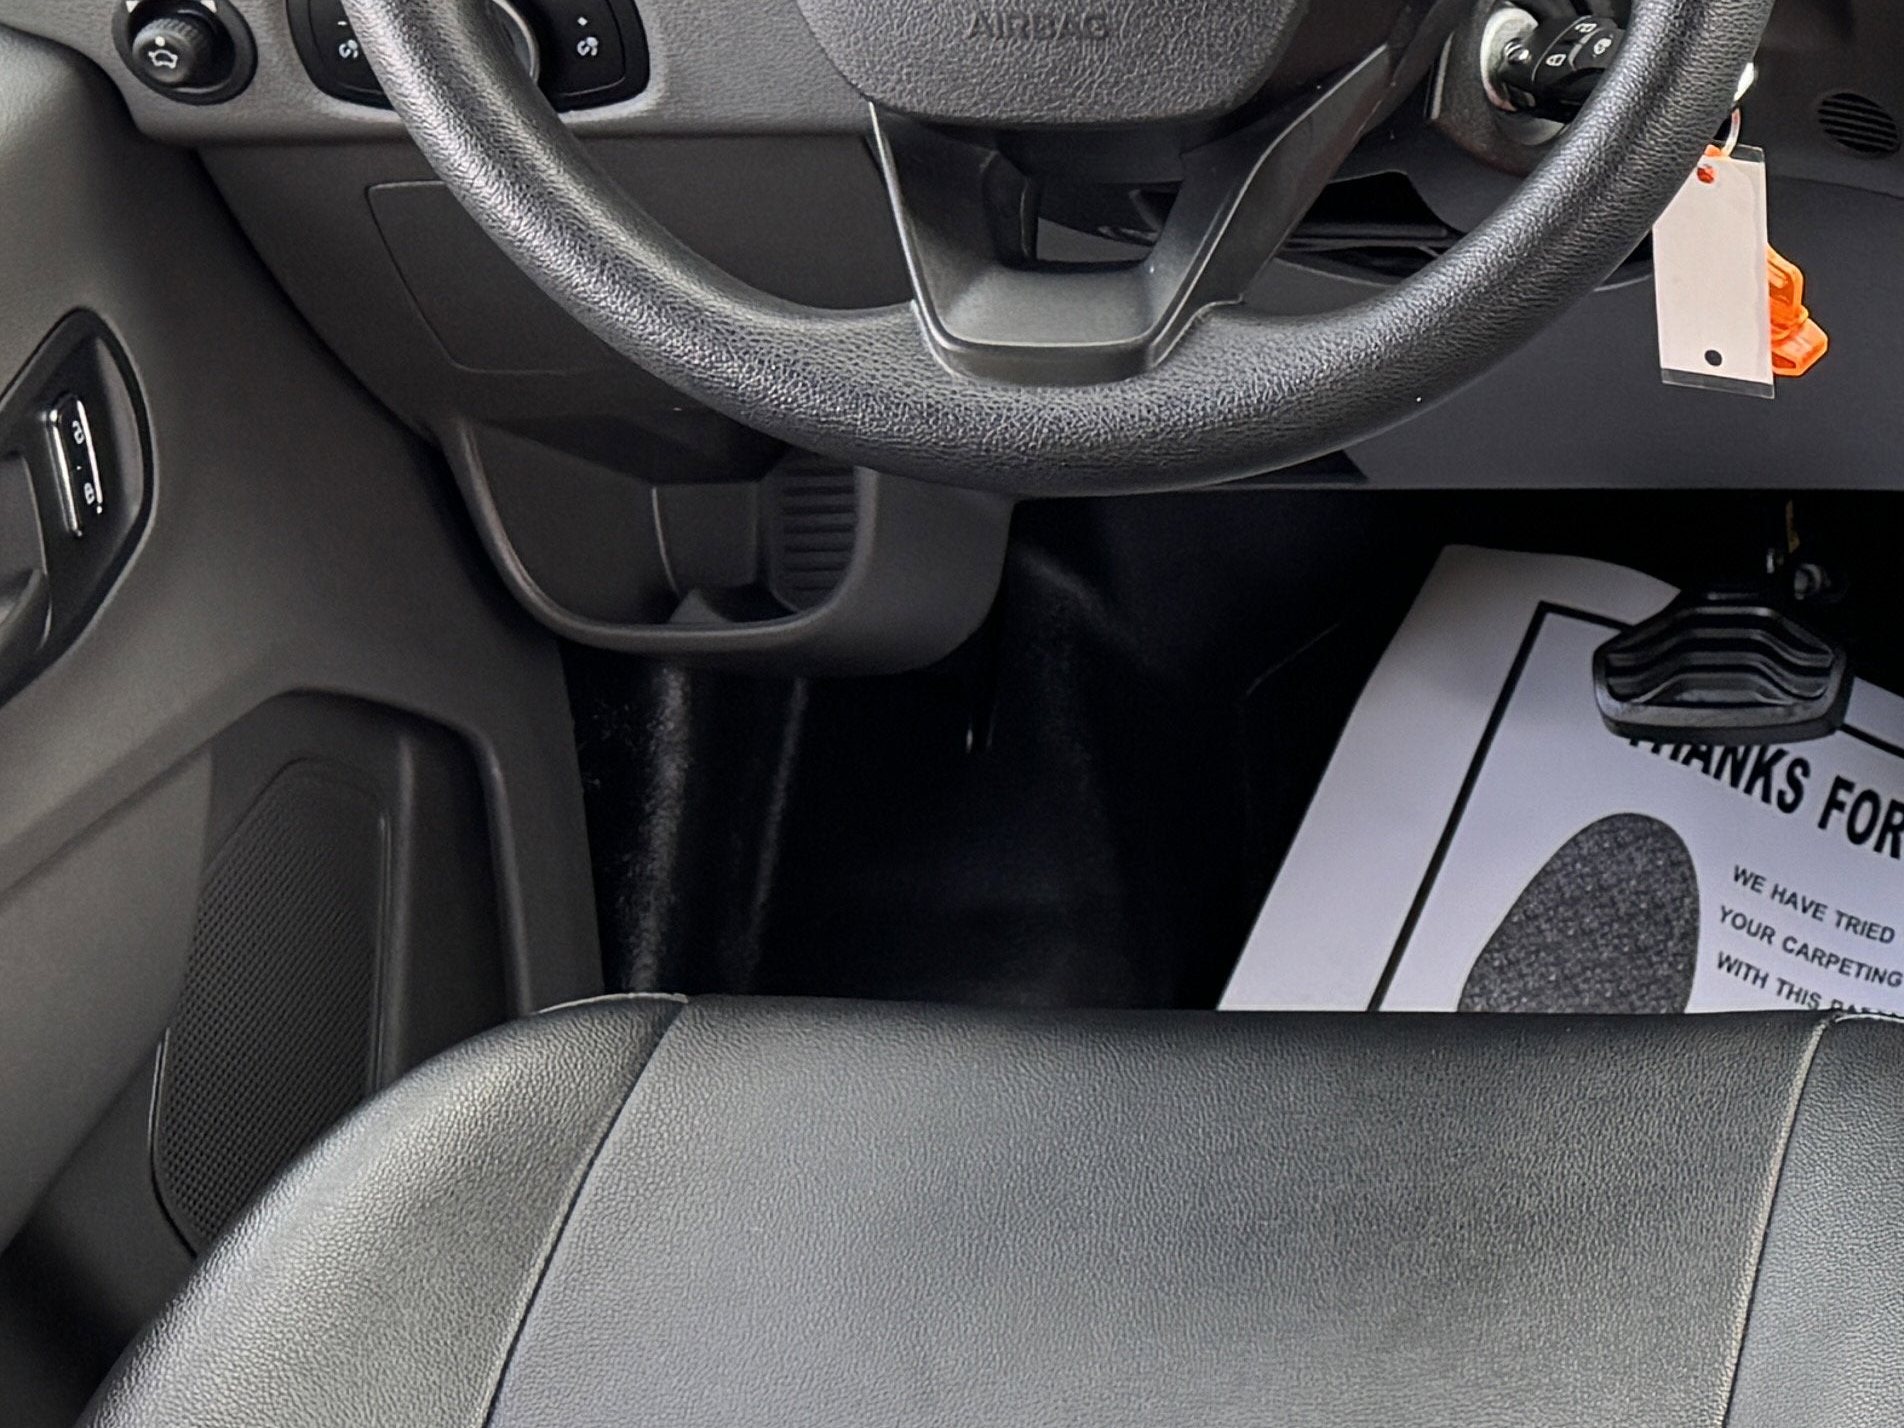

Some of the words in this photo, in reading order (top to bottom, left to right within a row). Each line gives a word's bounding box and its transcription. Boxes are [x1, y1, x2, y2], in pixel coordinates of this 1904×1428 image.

[966, 10, 1112, 43] AIRBAG
[1629, 739, 1811, 814] ANKS
[1733, 865, 1766, 893] WE
[1770, 883, 1828, 922] HAVE
[1834, 910, 1895, 944] TRIED
[1717, 951, 1769, 989] WITH
[1776, 977, 1823, 1011] THIS
[1720, 905, 1776, 946] YOUR
[1782, 935, 1903, 989] CARPETING
